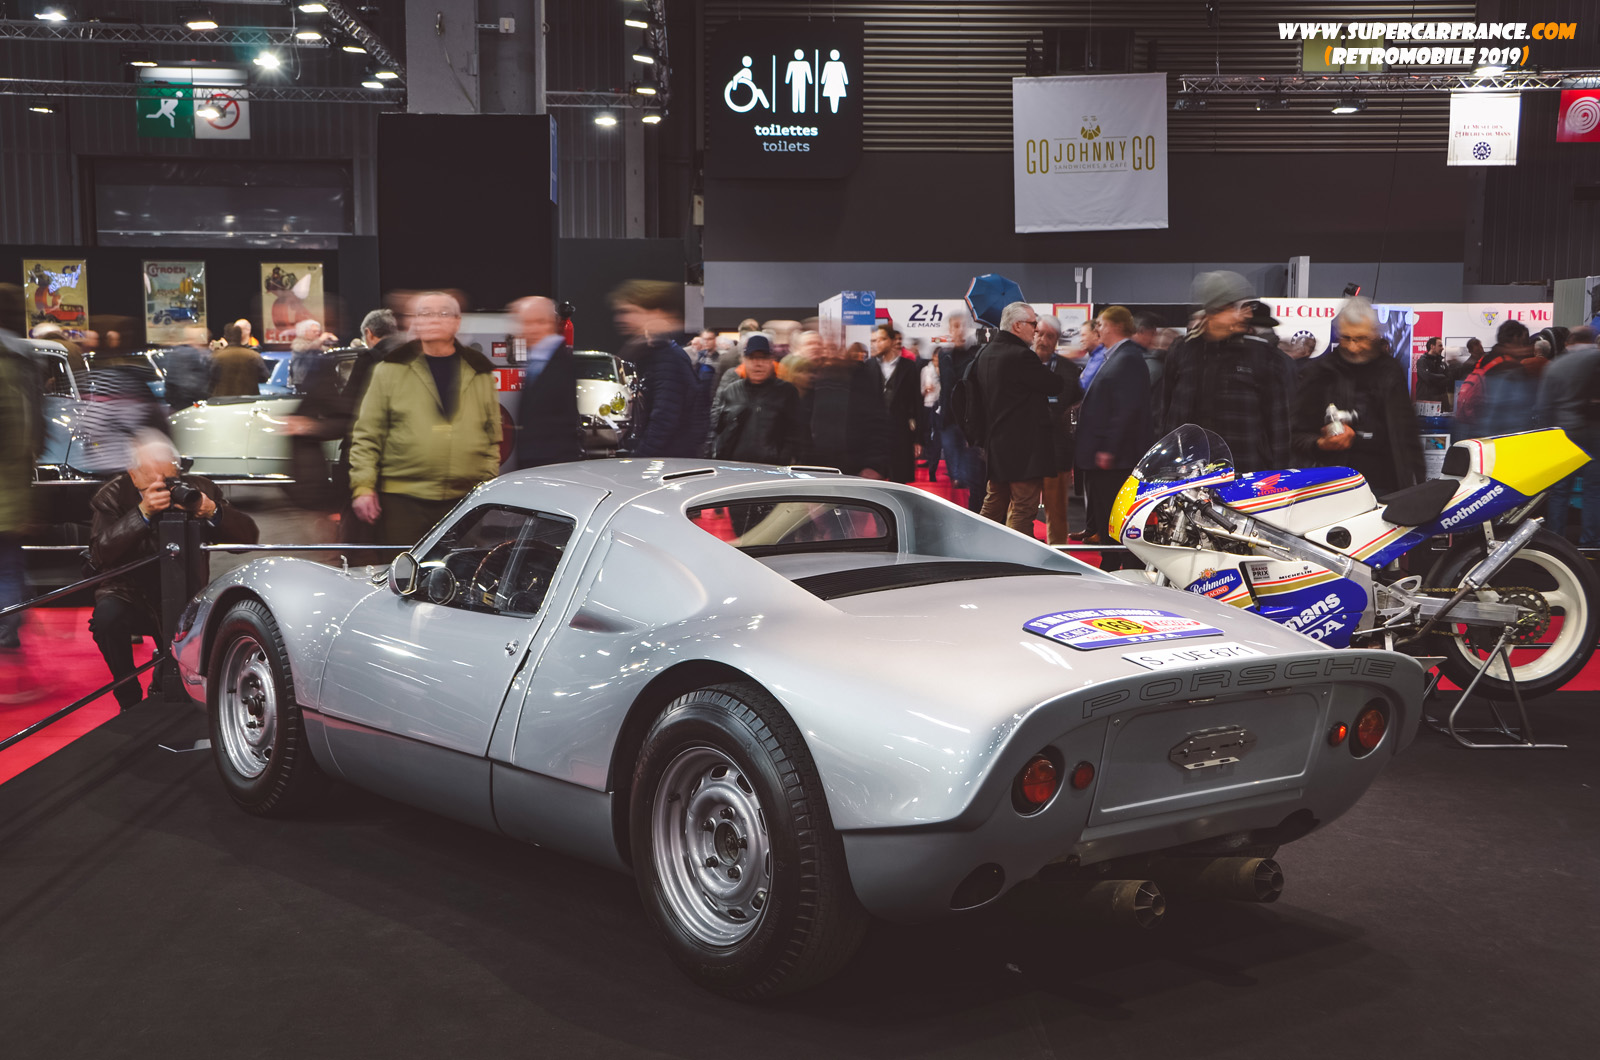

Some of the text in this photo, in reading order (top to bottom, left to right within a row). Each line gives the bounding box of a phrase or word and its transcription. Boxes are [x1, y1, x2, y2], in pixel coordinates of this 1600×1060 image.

[754, 123, 819, 136] toilettes
[762, 140, 810, 152] toilets
[1026, 135, 1155, 175] GO JOHNNY GO
[908, 303, 943, 322] 24h
[1276, 305, 1335, 318] LE CLUB
[1257, 486, 1290, 497] HONDA
[1440, 485, 1504, 530] Rothmans
[1279, 570, 1312, 580] MICHELIN
[1190, 573, 1237, 595] Rothmans
[1097, 620, 1142, 633] 160
[1209, 646, 1254, 657] 671
[1081, 656, 1397, 719] PORSCHE
